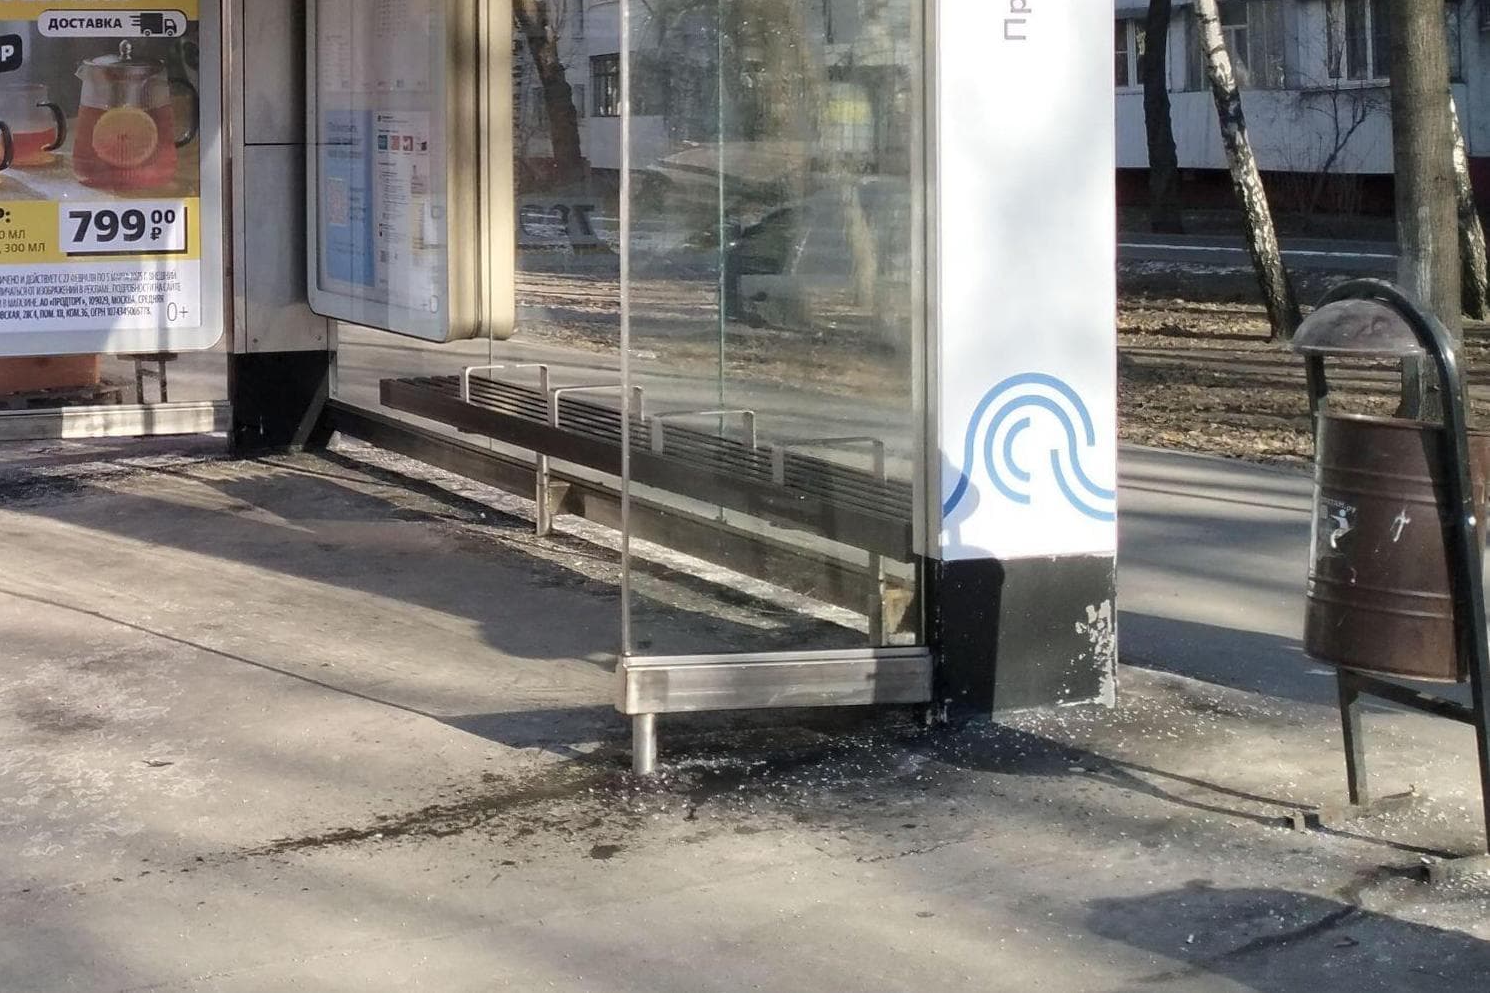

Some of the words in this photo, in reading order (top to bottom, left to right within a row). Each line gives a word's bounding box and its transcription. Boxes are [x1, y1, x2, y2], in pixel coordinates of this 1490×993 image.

[48, 17, 122, 30] ДОСТАВКА
[68, 209, 146, 243] 799
[150, 209, 176, 224] 00
[8, 229, 26, 240] МЛ
[5, 243, 25, 253] 300
[28, 243, 46, 252] МЛ
[166, 301, 189, 322] 0+
